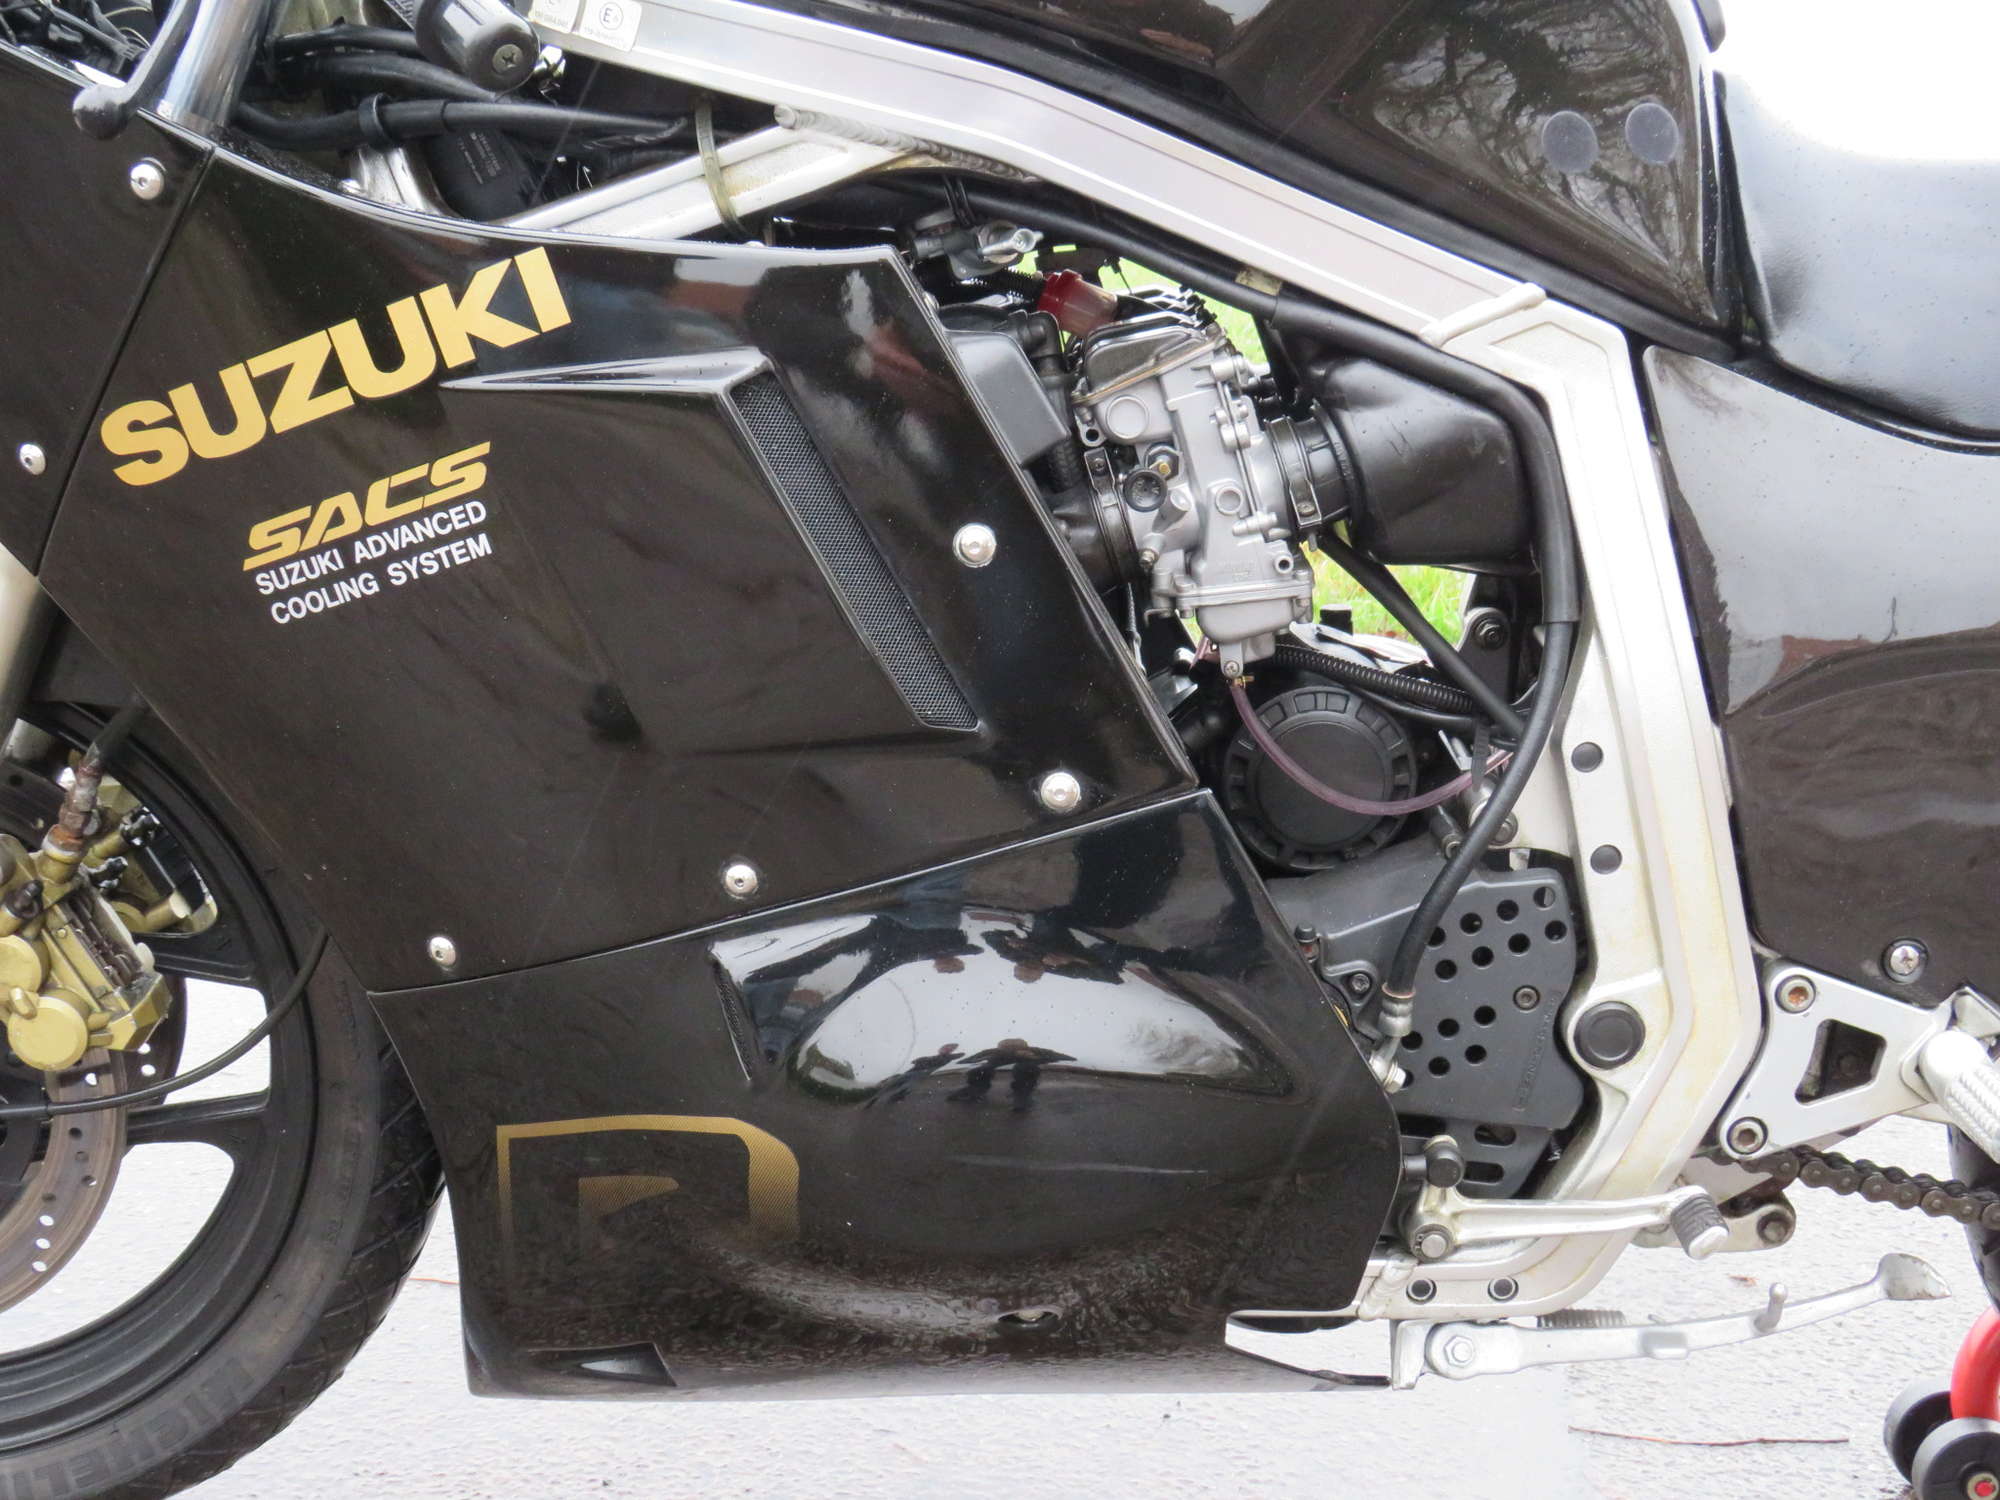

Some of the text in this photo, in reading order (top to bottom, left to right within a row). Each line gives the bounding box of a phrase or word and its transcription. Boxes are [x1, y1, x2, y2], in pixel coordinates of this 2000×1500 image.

[100, 246, 571, 486] SUZUKI
[243, 441, 491, 572] SACS
[255, 500, 487, 595] SUZUKI ADVANCED
[271, 533, 493, 624] COOLING SYSTEM
